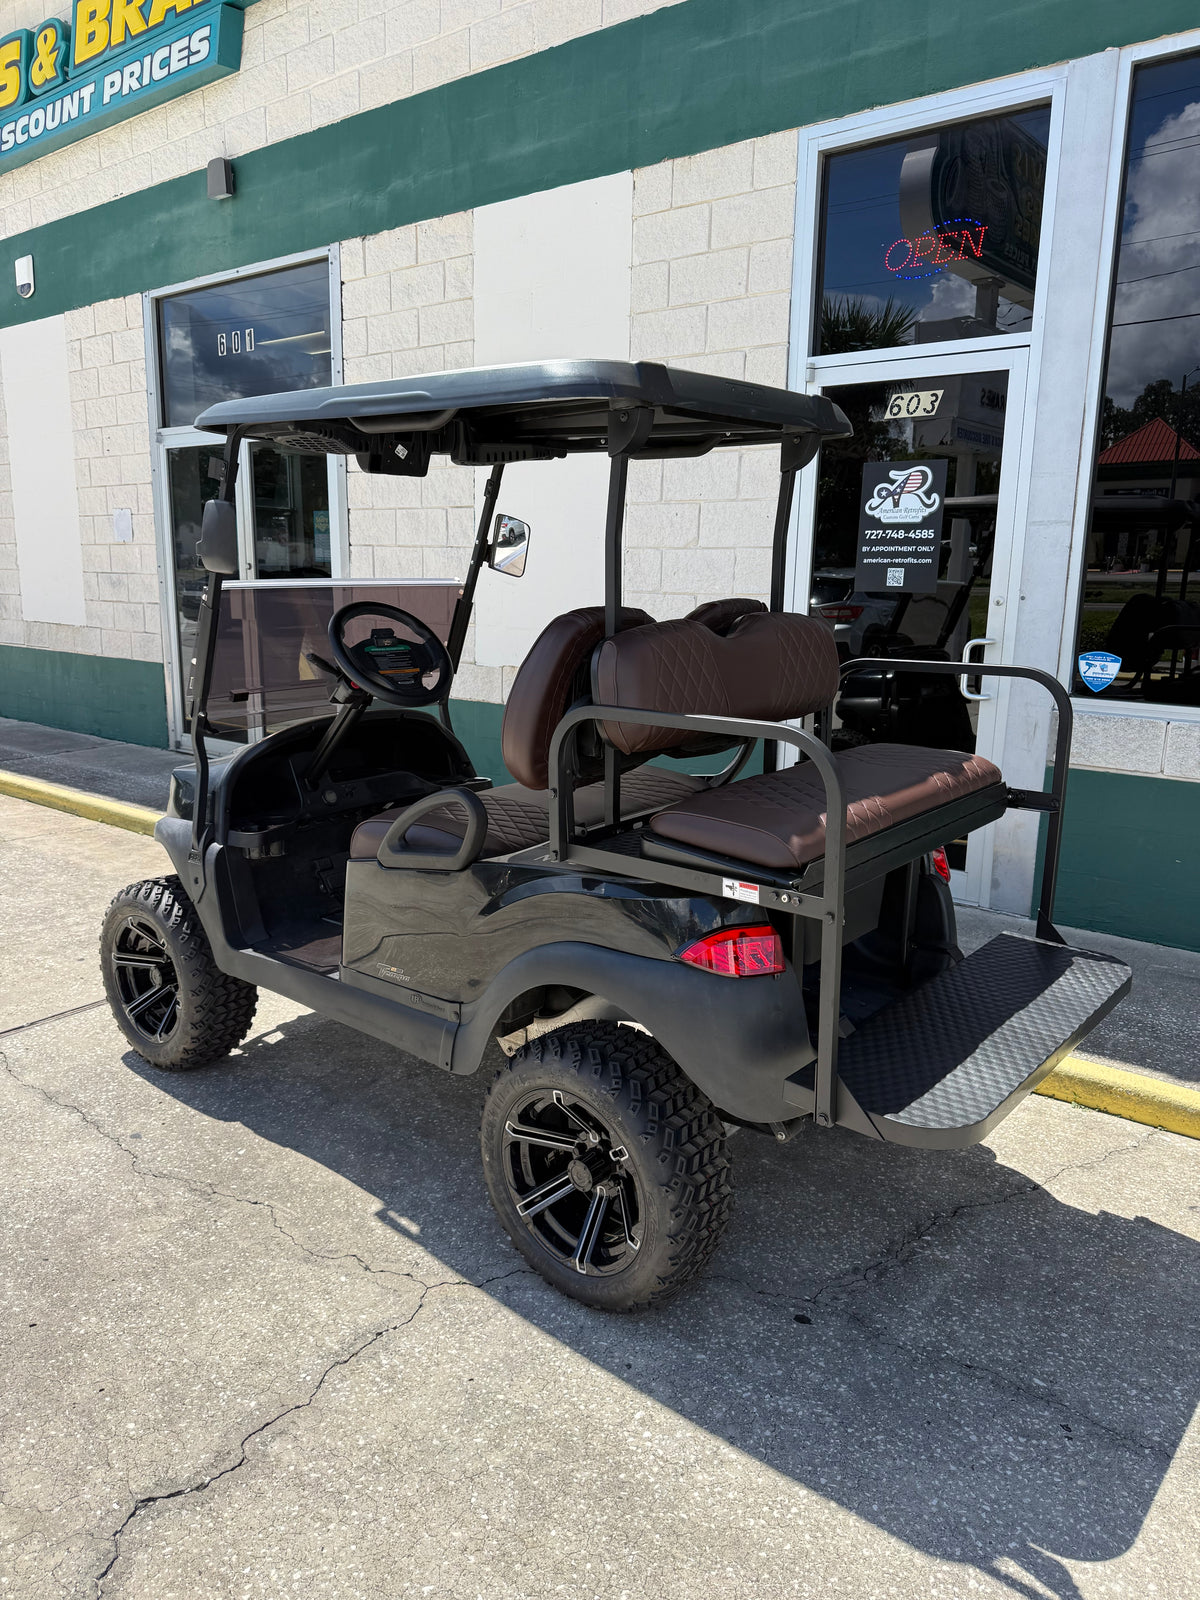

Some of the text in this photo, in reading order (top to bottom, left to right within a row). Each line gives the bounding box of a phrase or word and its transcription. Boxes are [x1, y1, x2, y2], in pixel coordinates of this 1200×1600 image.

[31, 27, 58, 87] &
[74, 0, 207, 66] BR
[102, 25, 211, 105] PRICES
[885, 226, 989, 272] OPEN
[219, 329, 253, 355] 601
[889, 393, 940, 417] 603
[864, 529, 935, 540] 727-748-4585
